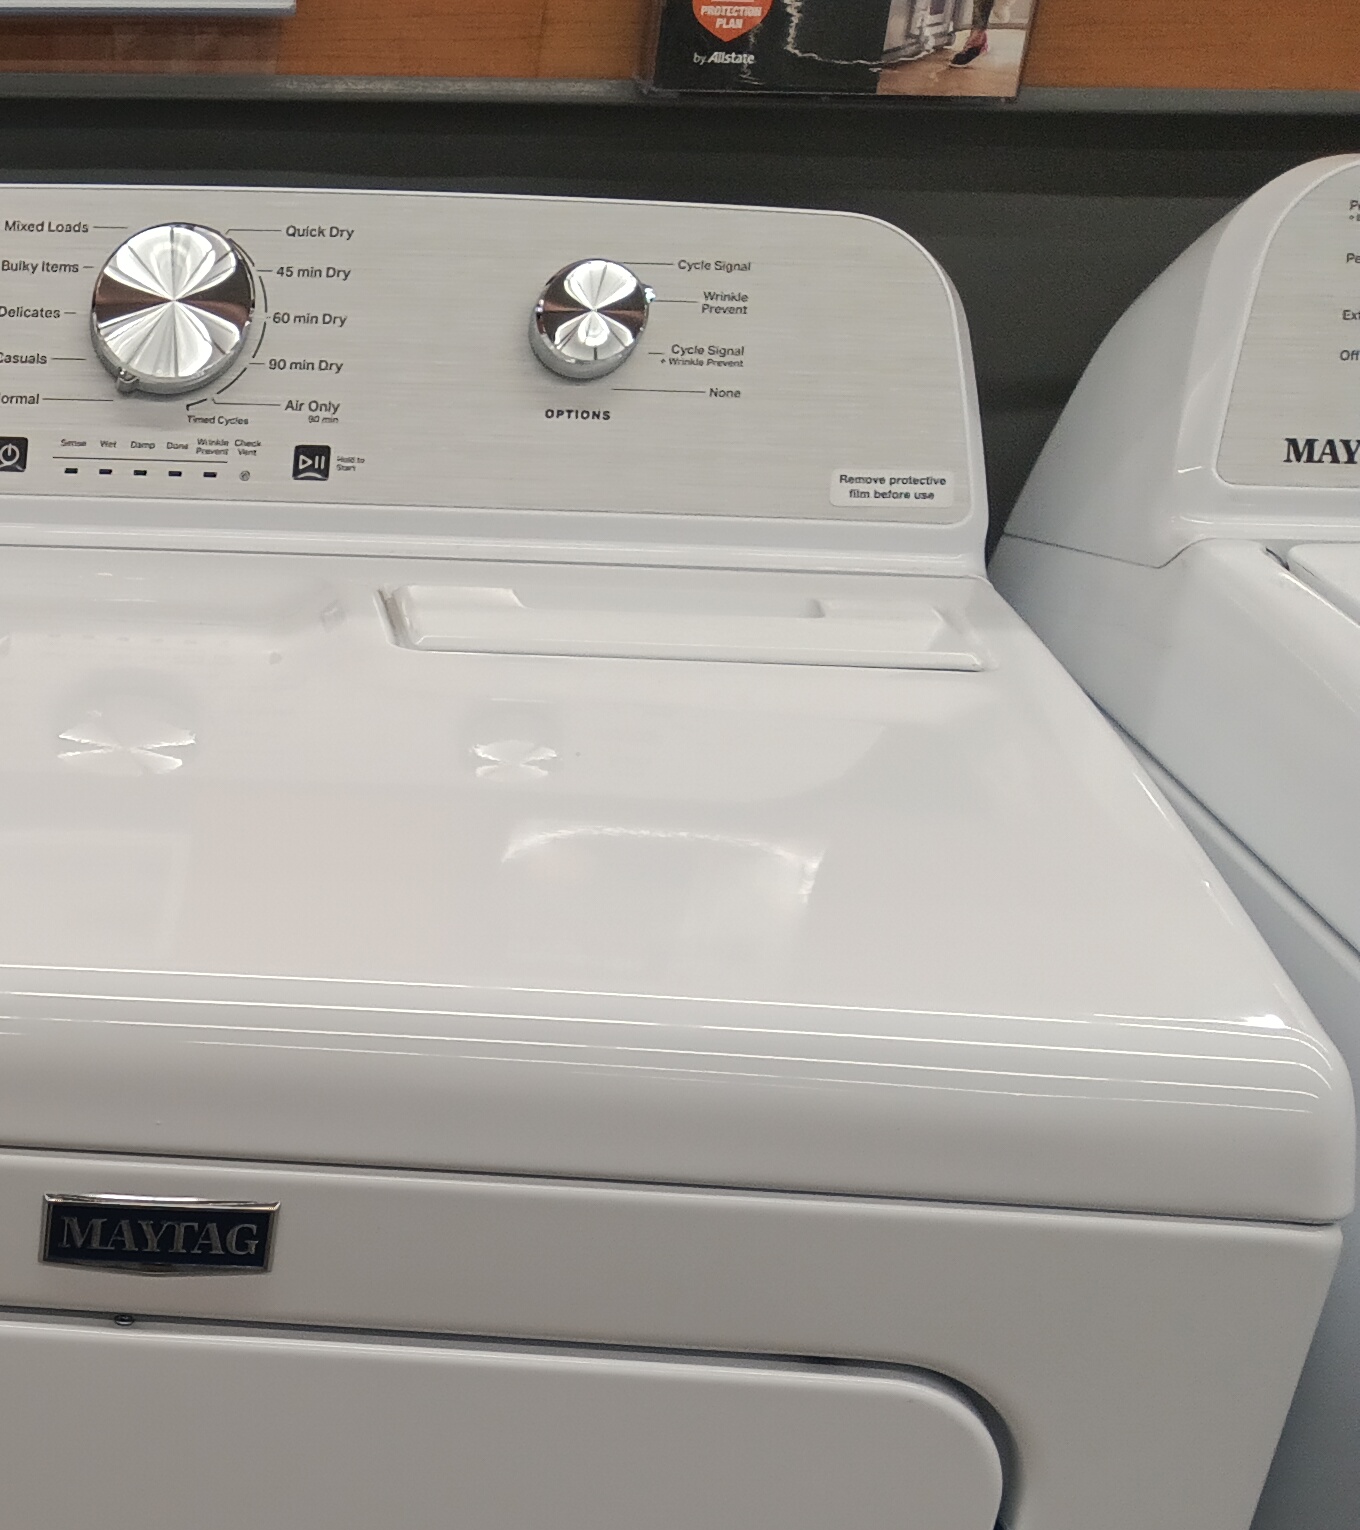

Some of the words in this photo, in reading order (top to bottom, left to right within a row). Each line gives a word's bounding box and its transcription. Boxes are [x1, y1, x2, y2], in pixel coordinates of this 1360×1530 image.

[700, 5, 762, 17] PROTECTION
[715, 18, 744, 29] PLAN
[692, 52, 707, 65] by
[707, 51, 755, 64] Allstate
[4, 220, 45, 233] Mixed
[47, 221, 89, 233] Loads
[285, 225, 326, 238] Quick
[329, 226, 355, 240] Dry
[1, 260, 38, 274] Bulky
[41, 261, 79, 273] Items
[678, 260, 711, 272] Cycle
[714, 260, 751, 273] Signal
[276, 266, 294, 278] 45
[297, 267, 322, 278] min
[325, 267, 351, 281] Dry
[703, 291, 749, 303] Wrinkle
[701, 303, 748, 315] Prevent
[272, 311, 290, 324] 60
[293, 312, 319, 324] min
[322, 313, 347, 327] Dry
[671, 345, 705, 356] Cycle
[708, 345, 745, 358] Signal
[268, 359, 286, 370] 90
[289, 359, 315, 370] min
[318, 360, 343, 374] Dry
[668, 358, 704, 367] Wrinkle
[706, 358, 744, 367] Prevent
[709, 388, 741, 398] None
[284, 400, 304, 411] Air
[308, 400, 340, 415] Only
[187, 415, 215, 424] Timed
[217, 416, 249, 426] Cycles
[545, 408, 611, 421] OPTIONS
[130, 441, 156, 450] Damp
[839, 474, 886, 484] Remove
[889, 475, 947, 486] protective
[849, 489, 870, 498] film
[873, 490, 911, 499] before
[914, 491, 935, 500] use
[58, 1216, 259, 1255] MAYTAG
